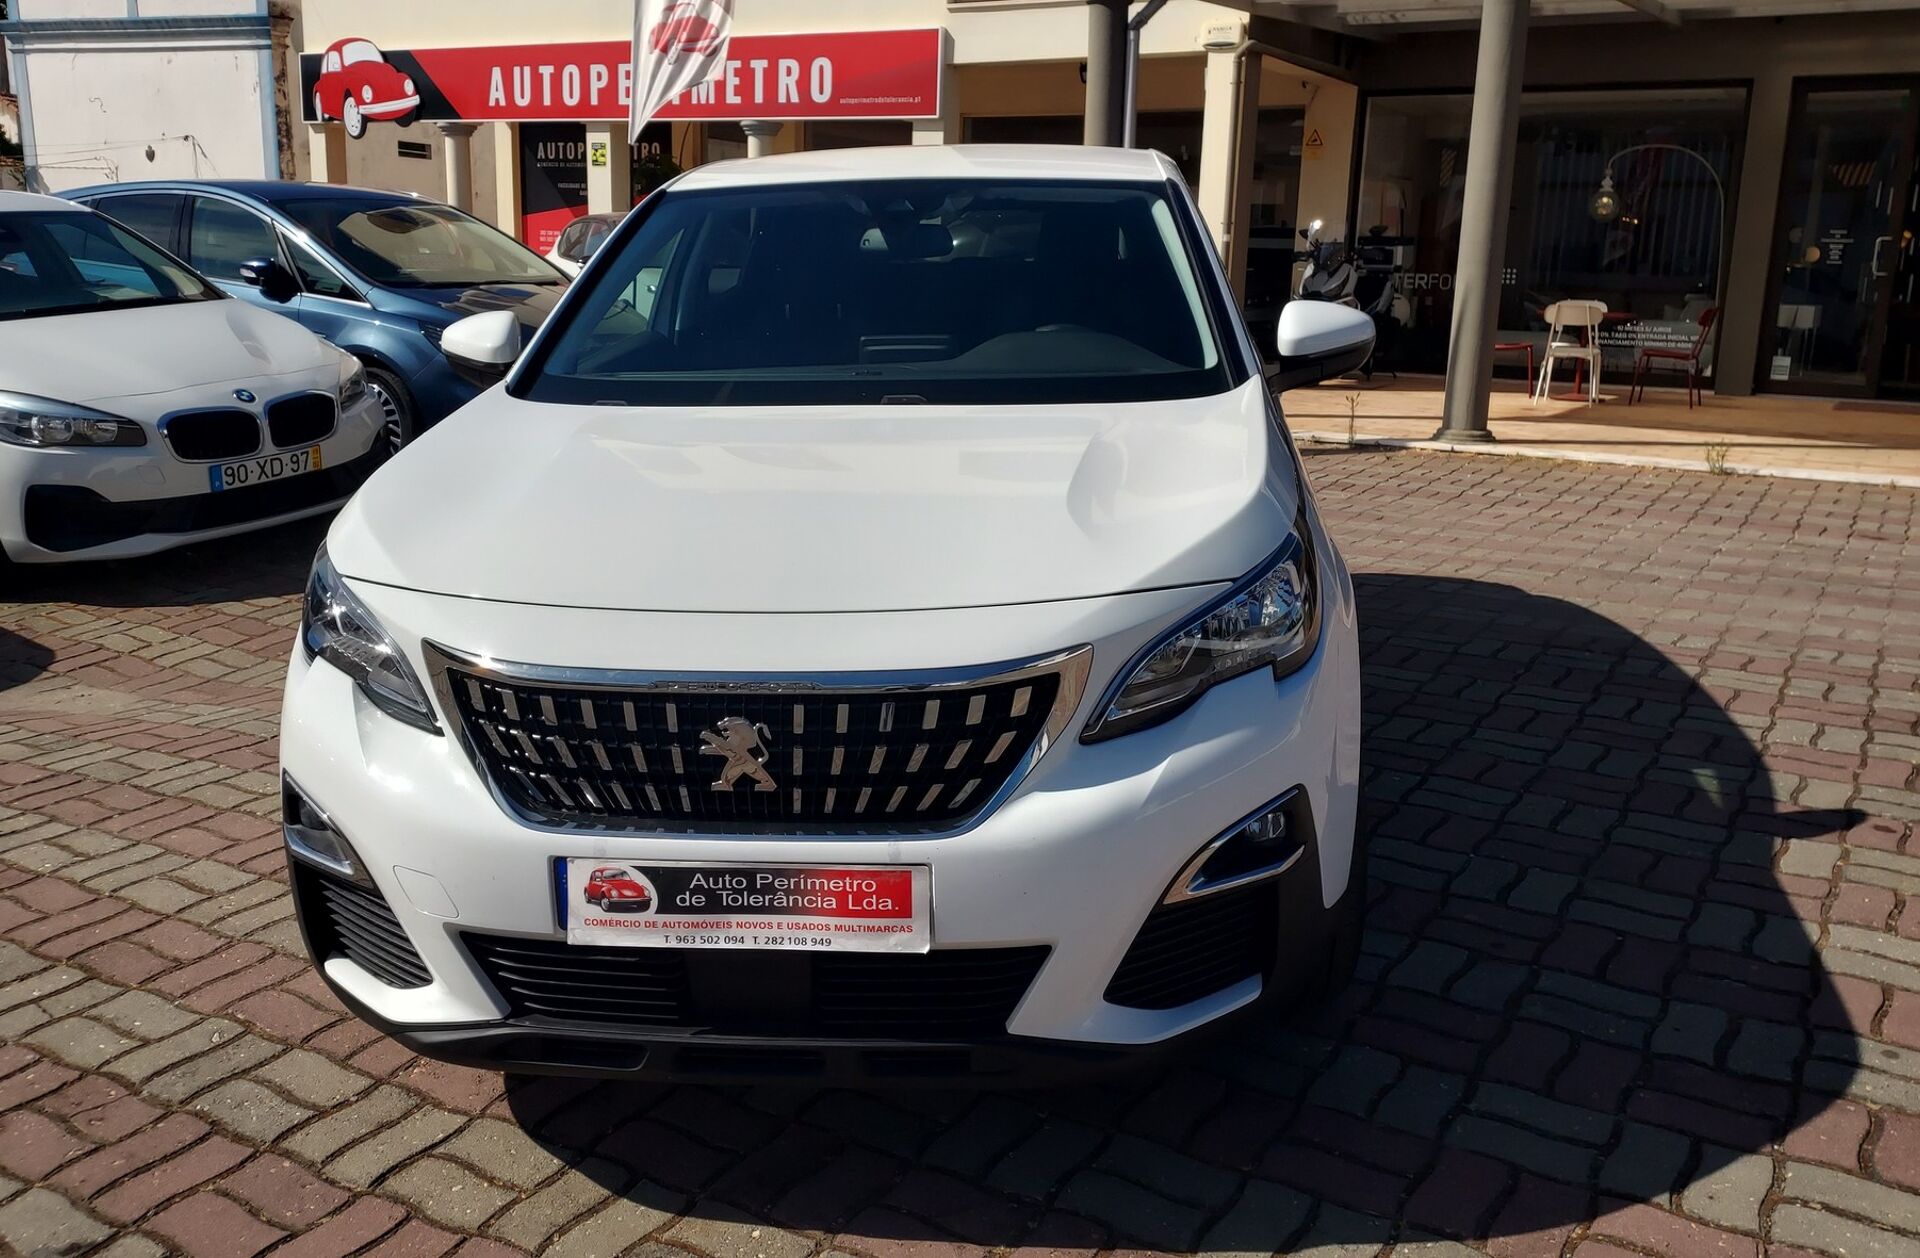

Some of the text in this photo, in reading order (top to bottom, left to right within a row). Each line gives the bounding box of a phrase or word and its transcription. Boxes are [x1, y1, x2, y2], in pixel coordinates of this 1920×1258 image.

[488, 57, 833, 107] AUTOPEMETRO
[689, 872, 877, 893] Auto Perímetro
[676, 890, 899, 911] de Tolerância Lda.
[584, 917, 913, 933] COMÉRCIO DE AUTOMÓVEIS NOVOS E USADOS MULTIMARCAS
[664, 935, 832, 947] T. 963 502 094 T. 282 108 949
